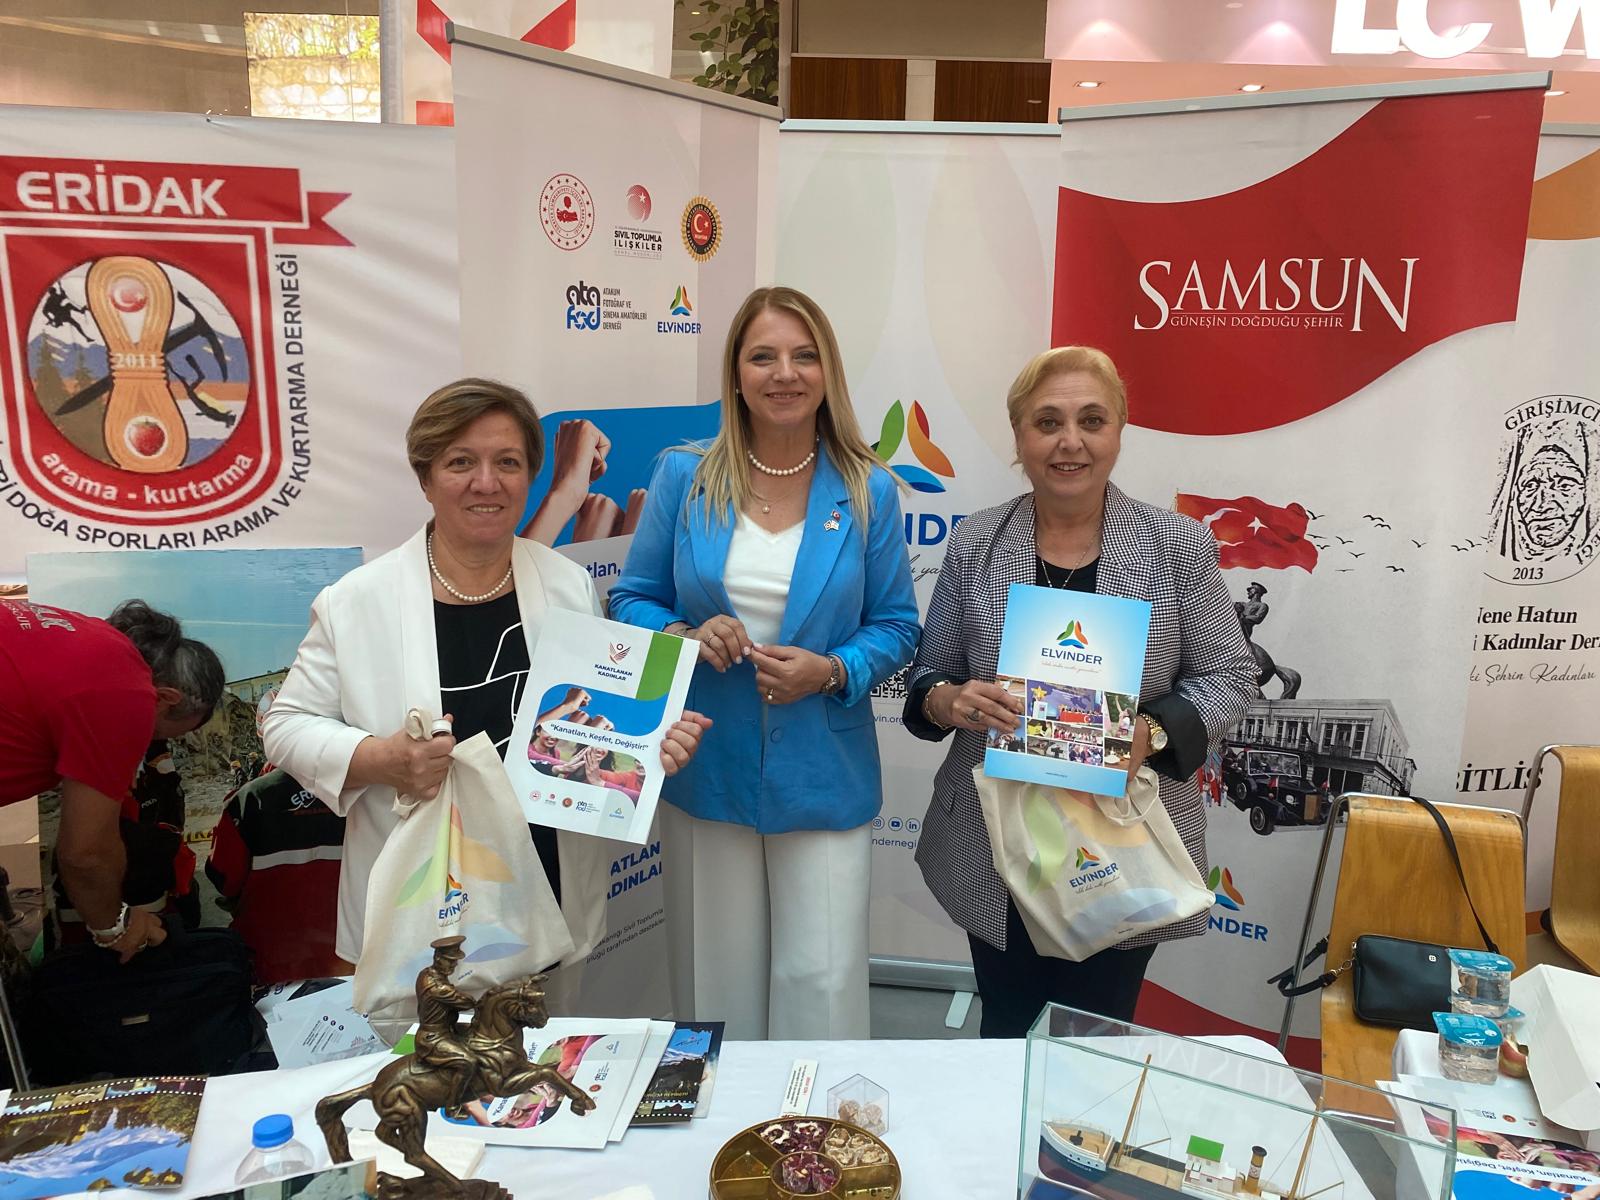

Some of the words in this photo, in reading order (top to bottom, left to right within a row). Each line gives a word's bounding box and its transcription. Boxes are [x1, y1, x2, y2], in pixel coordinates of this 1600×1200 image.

[16, 163, 228, 217] ERİDAK
[274, 252, 305, 356] DERNEĞİ
[626, 300, 632, 309] VE
[1134, 257, 1420, 332] SAMSUN
[1170, 314, 1226, 329] GÜNEŞİN
[1231, 314, 1301, 328] DOĞDUĞU
[1303, 315, 1344, 330] ŞEHİR
[114, 352, 158, 369] 2011
[286, 361, 313, 484] KURTARMA
[41, 451, 119, 501] arama
[144, 451, 254, 505] kurtarma
[271, 481, 302, 511] VE
[6, 490, 70, 538] DOĞA
[201, 504, 280, 547] ARAMA
[75, 524, 197, 551] SPORLARI
[1512, 567, 1545, 581] 2013
[1515, 605, 1578, 624] Hatun
[1481, 632, 1567, 651] Kadınlar
[594, 663, 633, 677] KANATLANAN
[597, 670, 627, 682] KADINLAR
[1456, 760, 1544, 793] İTLİS
